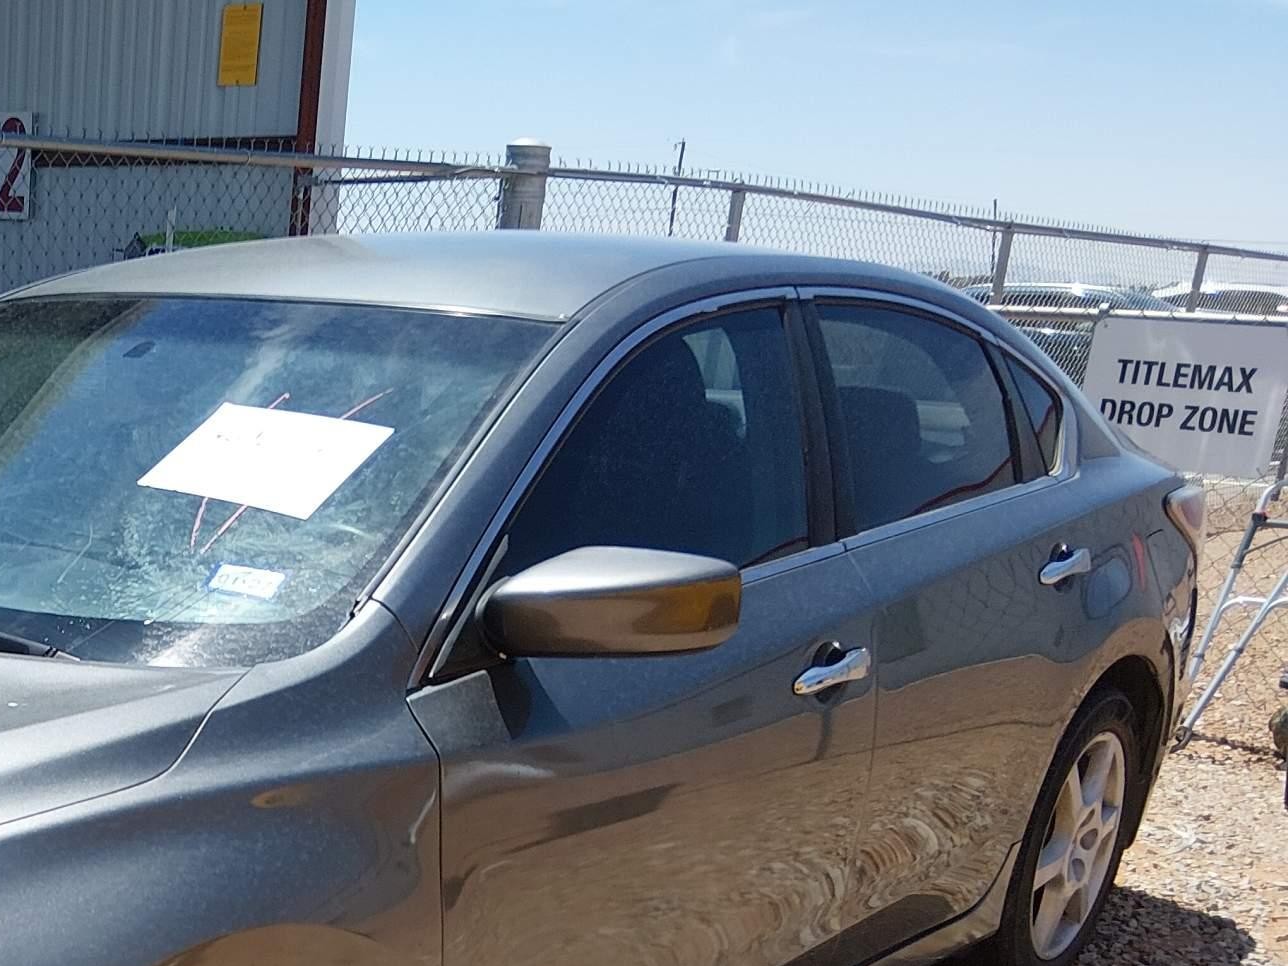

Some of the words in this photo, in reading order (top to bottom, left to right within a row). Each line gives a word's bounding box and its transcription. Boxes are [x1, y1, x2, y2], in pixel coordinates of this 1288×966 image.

[1117, 358, 1258, 394] TITLEMAX
[1099, 398, 1174, 428] DROP
[1179, 405, 1258, 436] ZONE
